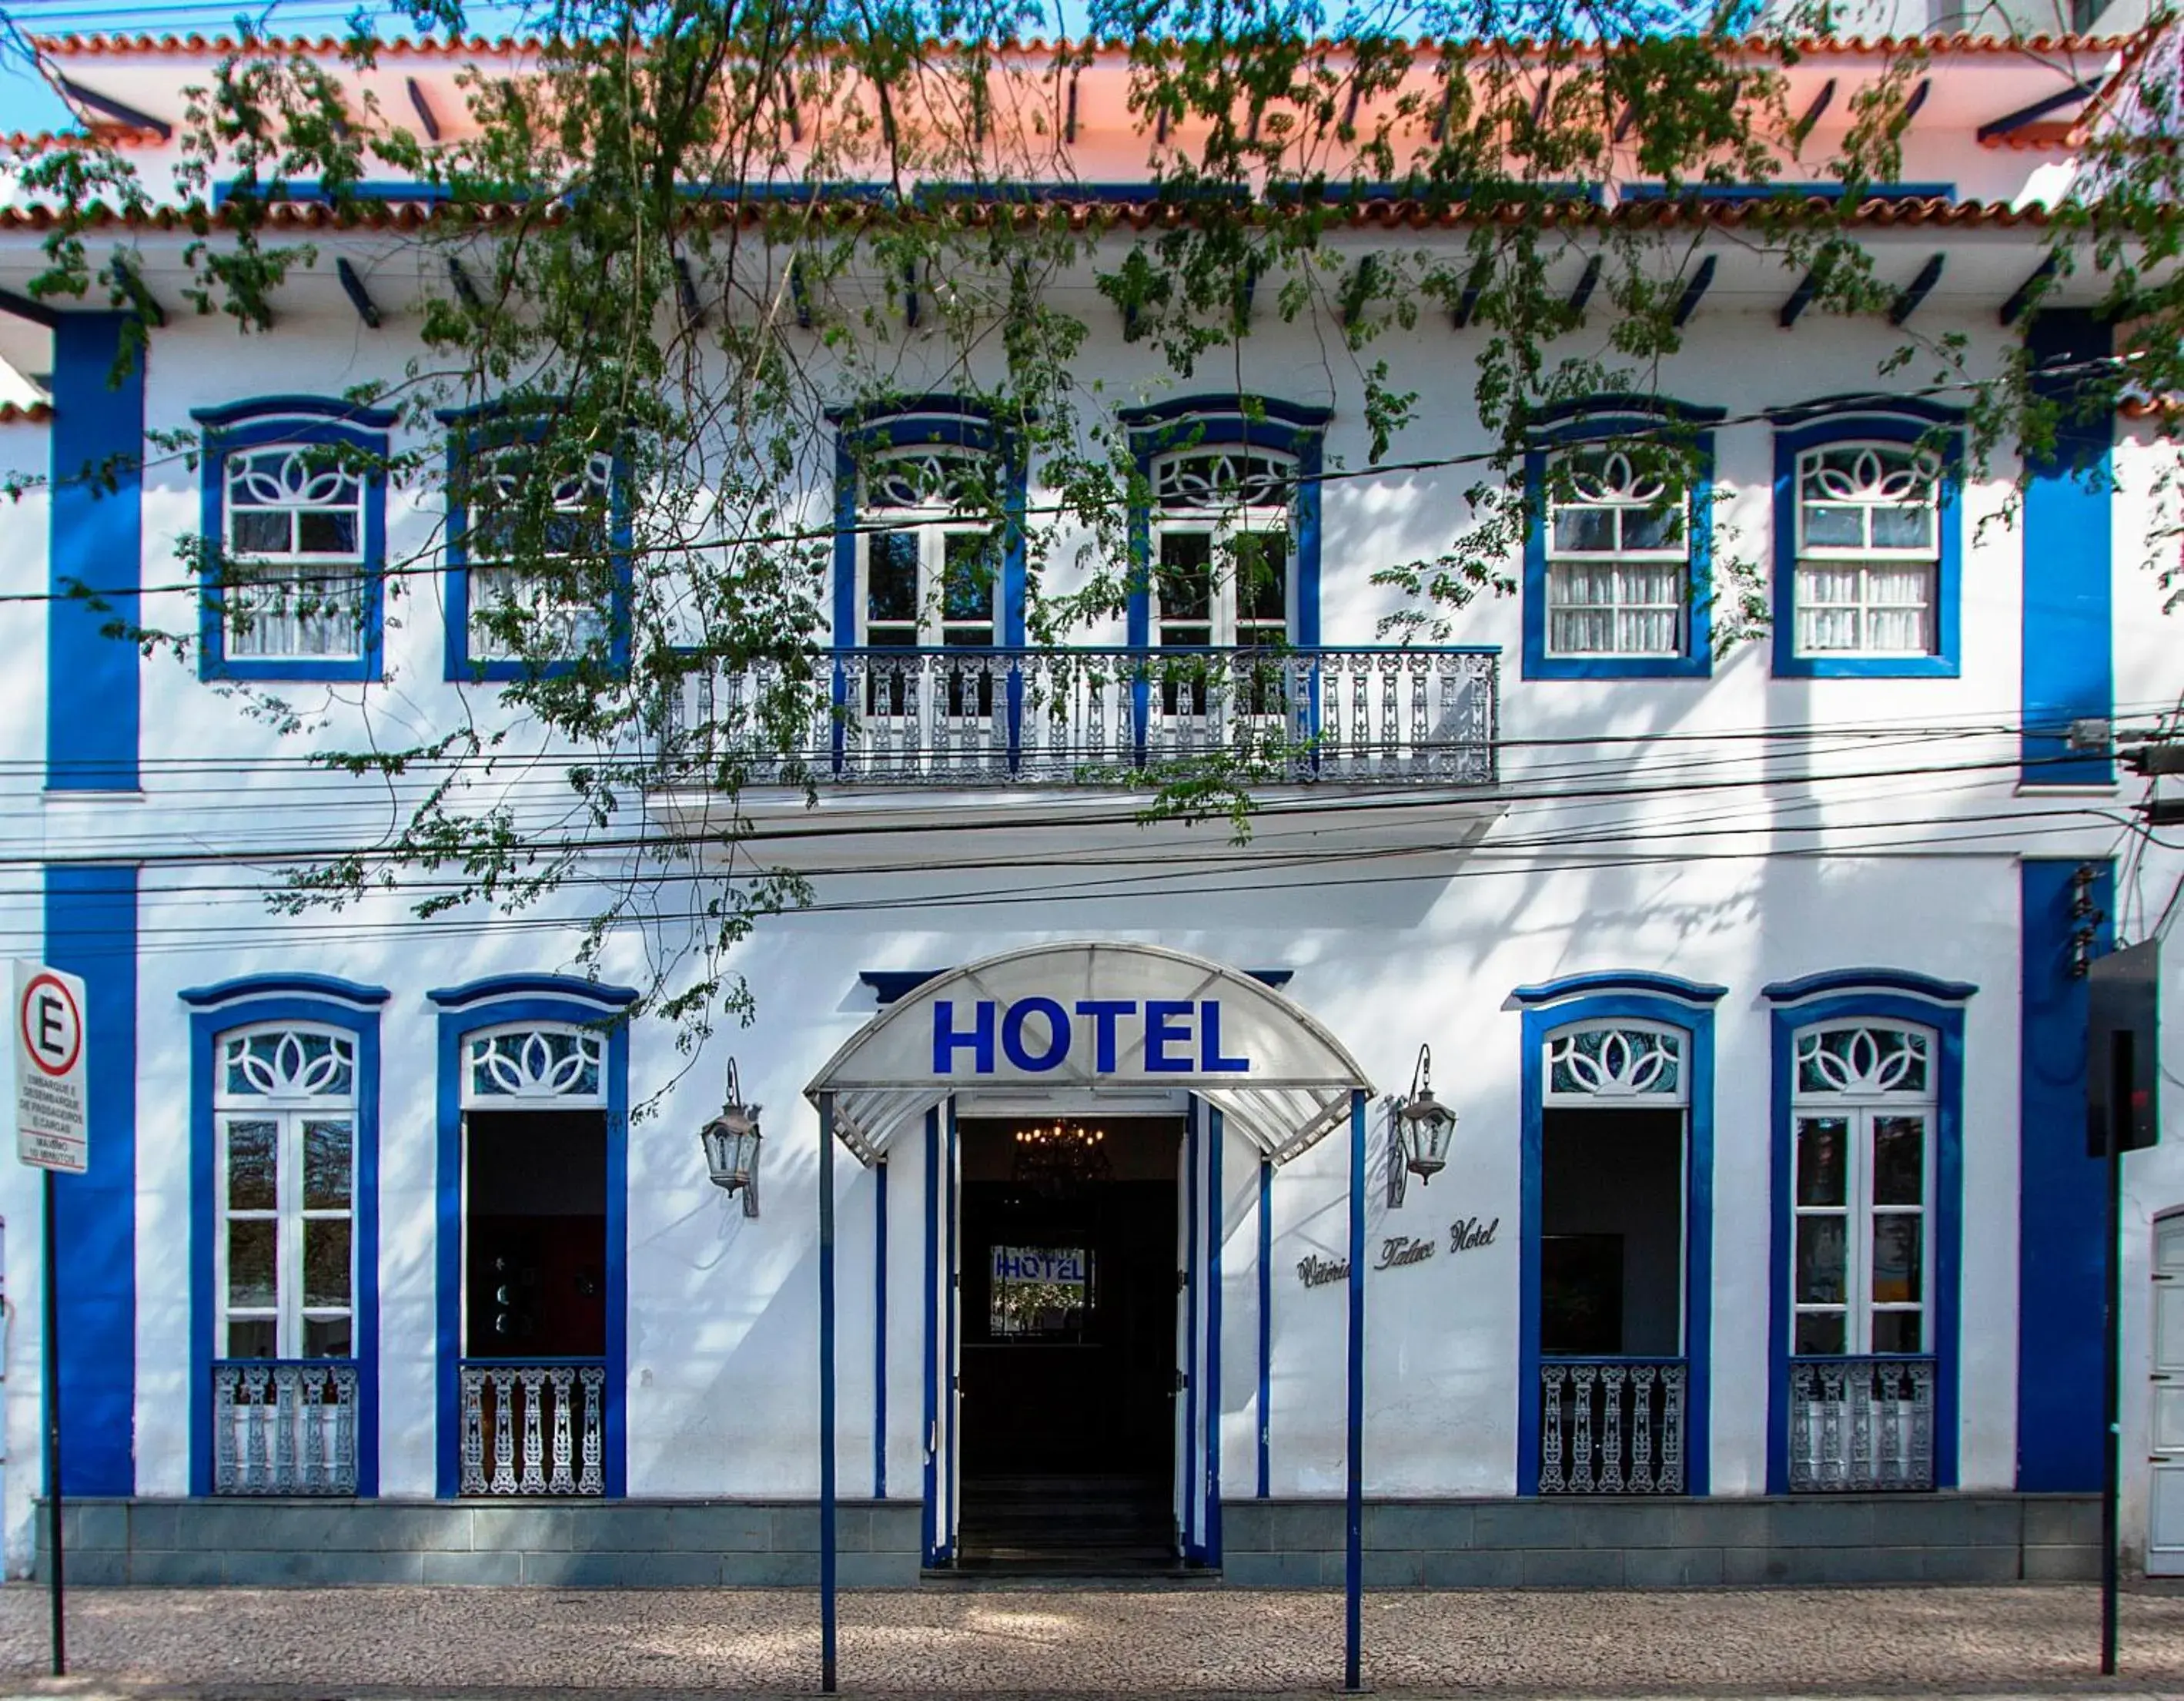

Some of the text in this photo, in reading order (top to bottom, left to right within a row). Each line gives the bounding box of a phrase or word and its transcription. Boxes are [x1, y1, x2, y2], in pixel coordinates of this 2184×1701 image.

[41, 994, 63, 1054] E
[933, 997, 1250, 1073] HOTEL
[1450, 1217, 1499, 1254] Hotel
